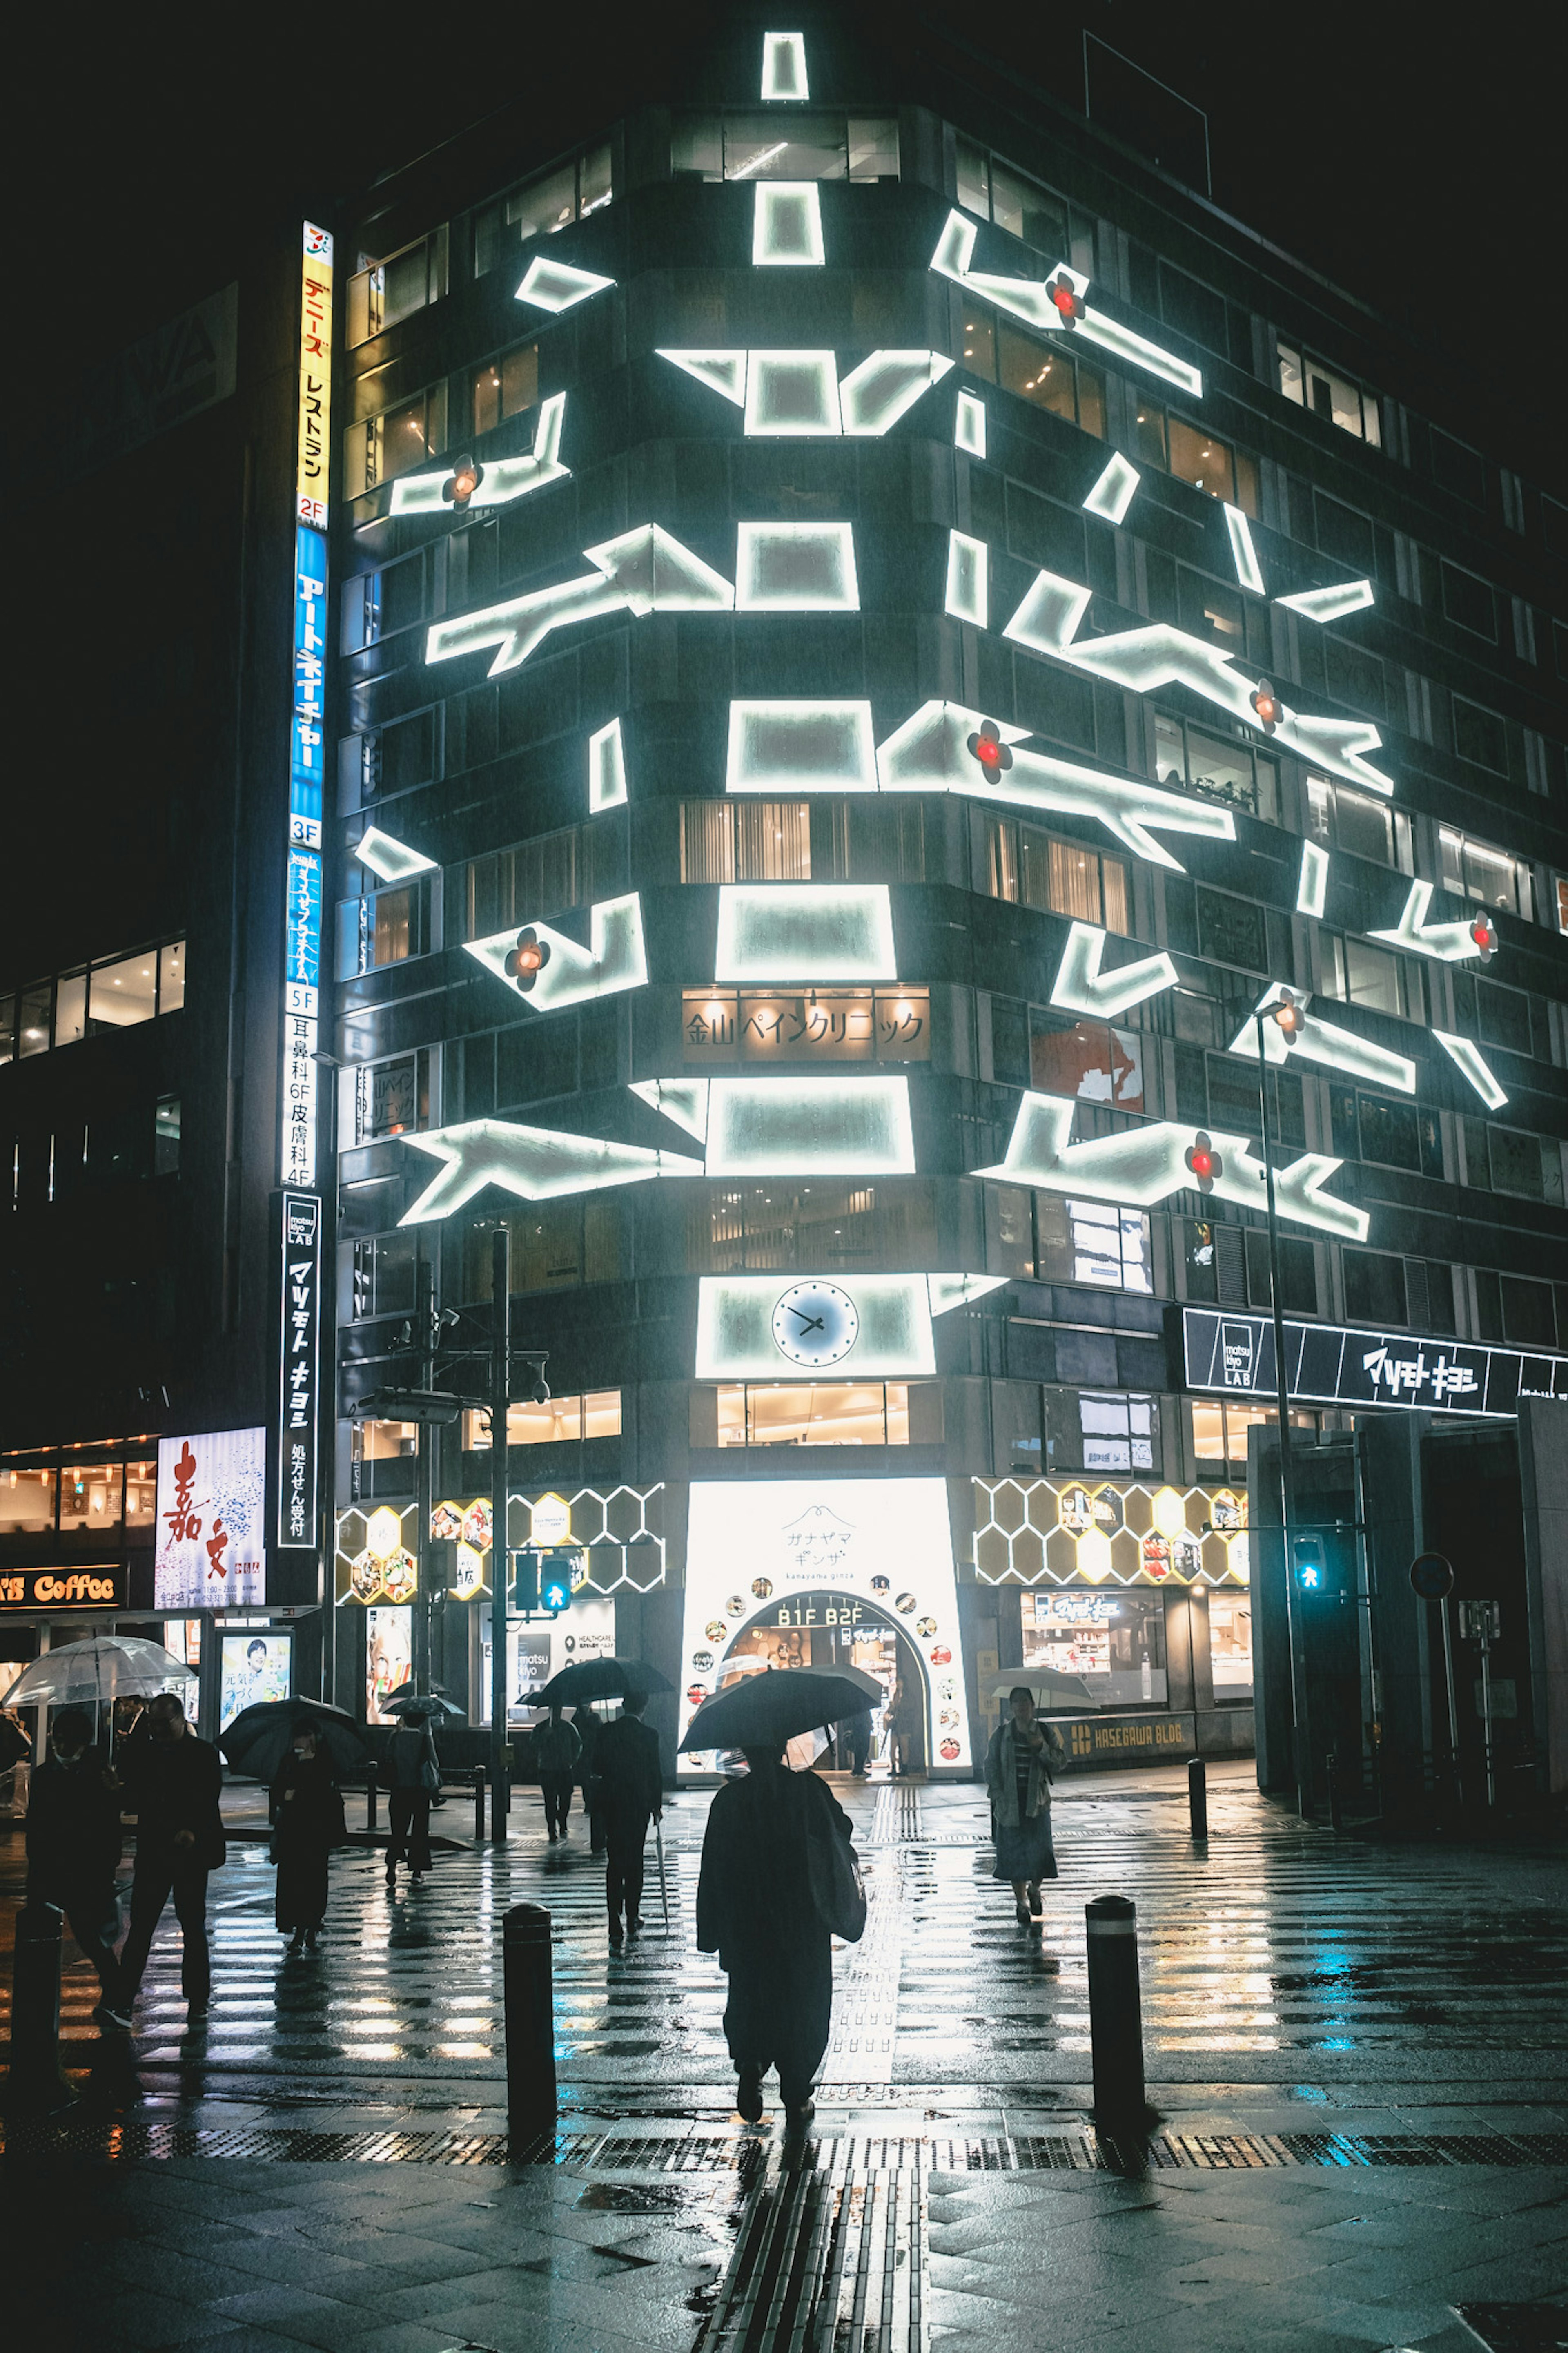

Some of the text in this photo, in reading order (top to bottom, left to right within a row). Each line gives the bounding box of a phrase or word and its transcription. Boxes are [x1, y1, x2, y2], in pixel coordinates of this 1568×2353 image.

[305, 277, 330, 478] デニーズ レストラン
[301, 498, 323, 518] 2F
[296, 573, 324, 767] アートネイチャー
[294, 821, 317, 841] 3F
[292, 990, 312, 1008] 5F
[686, 1013, 923, 1045] 金山ペインクリニック
[290, 1216, 313, 1226] matsu
[287, 1233, 313, 1246] LAB
[1226, 1345, 1250, 1357] matsu
[1226, 1354, 1242, 1370] kiyo
[1225, 1371, 1250, 1386] LAB
[289, 1443, 306, 1537] 処方せん受付
[795, 1550, 846, 1566] ギンザ
[34, 1574, 114, 1602] Coffee
[778, 1608, 862, 1626] B1F B2F
[520, 1654, 548, 1664] matsu
[226, 1688, 252, 1698] つづく
[1095, 1725, 1153, 1749] HASEGAWA
